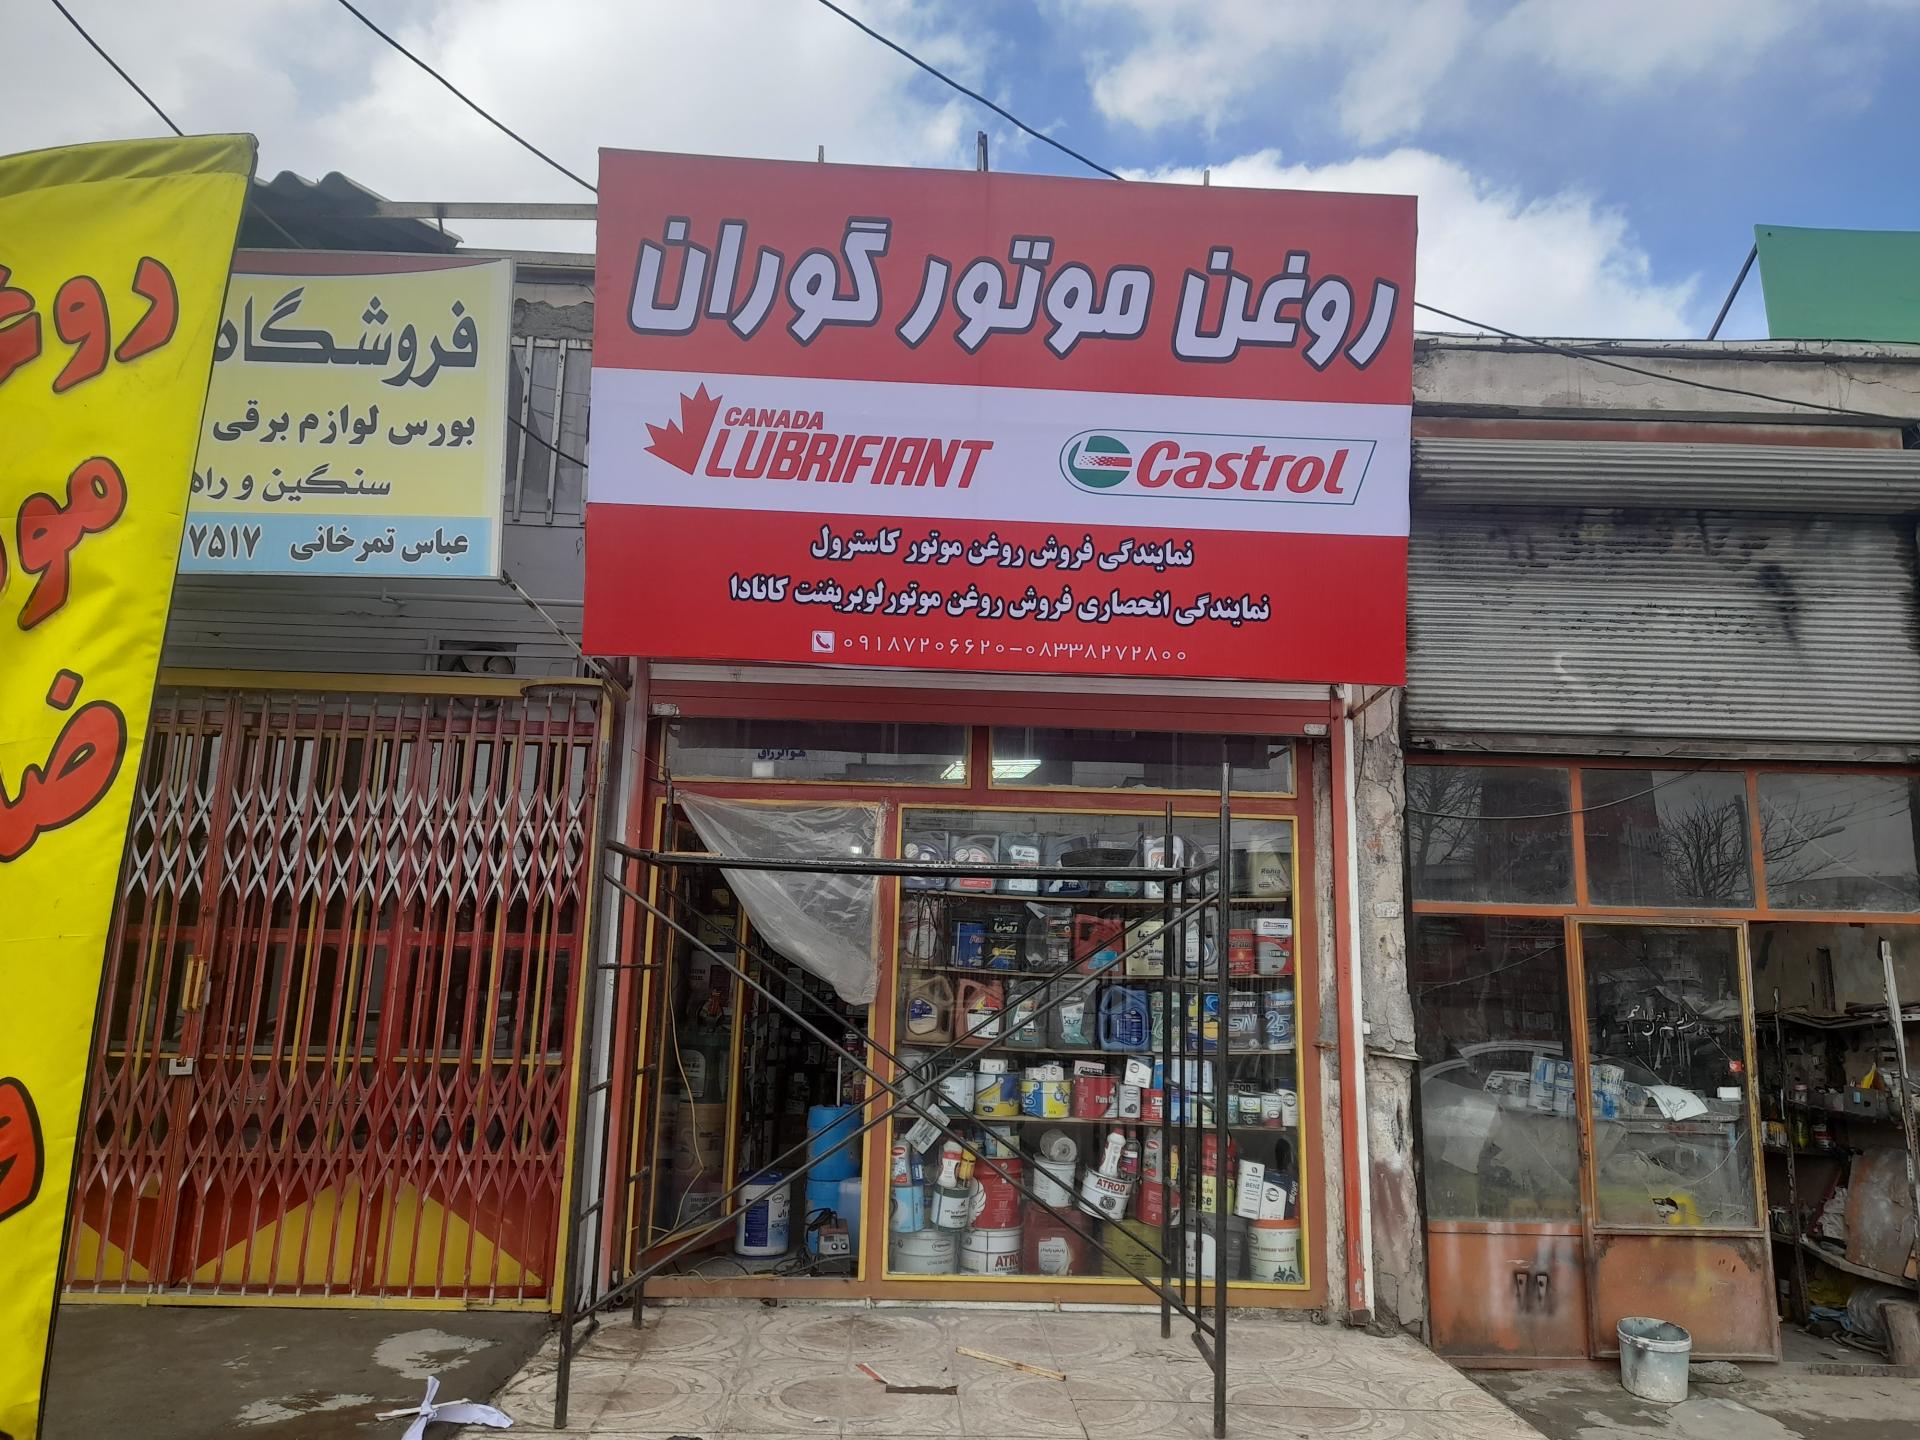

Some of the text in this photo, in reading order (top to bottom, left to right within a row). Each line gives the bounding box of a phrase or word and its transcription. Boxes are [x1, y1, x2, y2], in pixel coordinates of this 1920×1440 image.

[627, 215, 1398, 371] روغن موتور گوران
[213, 400, 476, 448] بورس لوازم برقی
[724, 406, 824, 431] CANADA
[704, 427, 995, 489] LUBRIFIANT
[1136, 439, 1350, 496] Castrol
[235, 475, 254, 501] و
[262, 463, 391, 502] سنگین
[401, 528, 469, 563] عباس
[810, 524, 1195, 572] نمایندگی فروش روغن موتور کاسترول
[728, 572, 789, 601] کانادا
[945, 583, 1004, 619] روغن
[1007, 585, 1074, 622] فروش
[1077, 588, 1171, 623] انحصاری
[1174, 594, 1271, 628] نمایندگی
